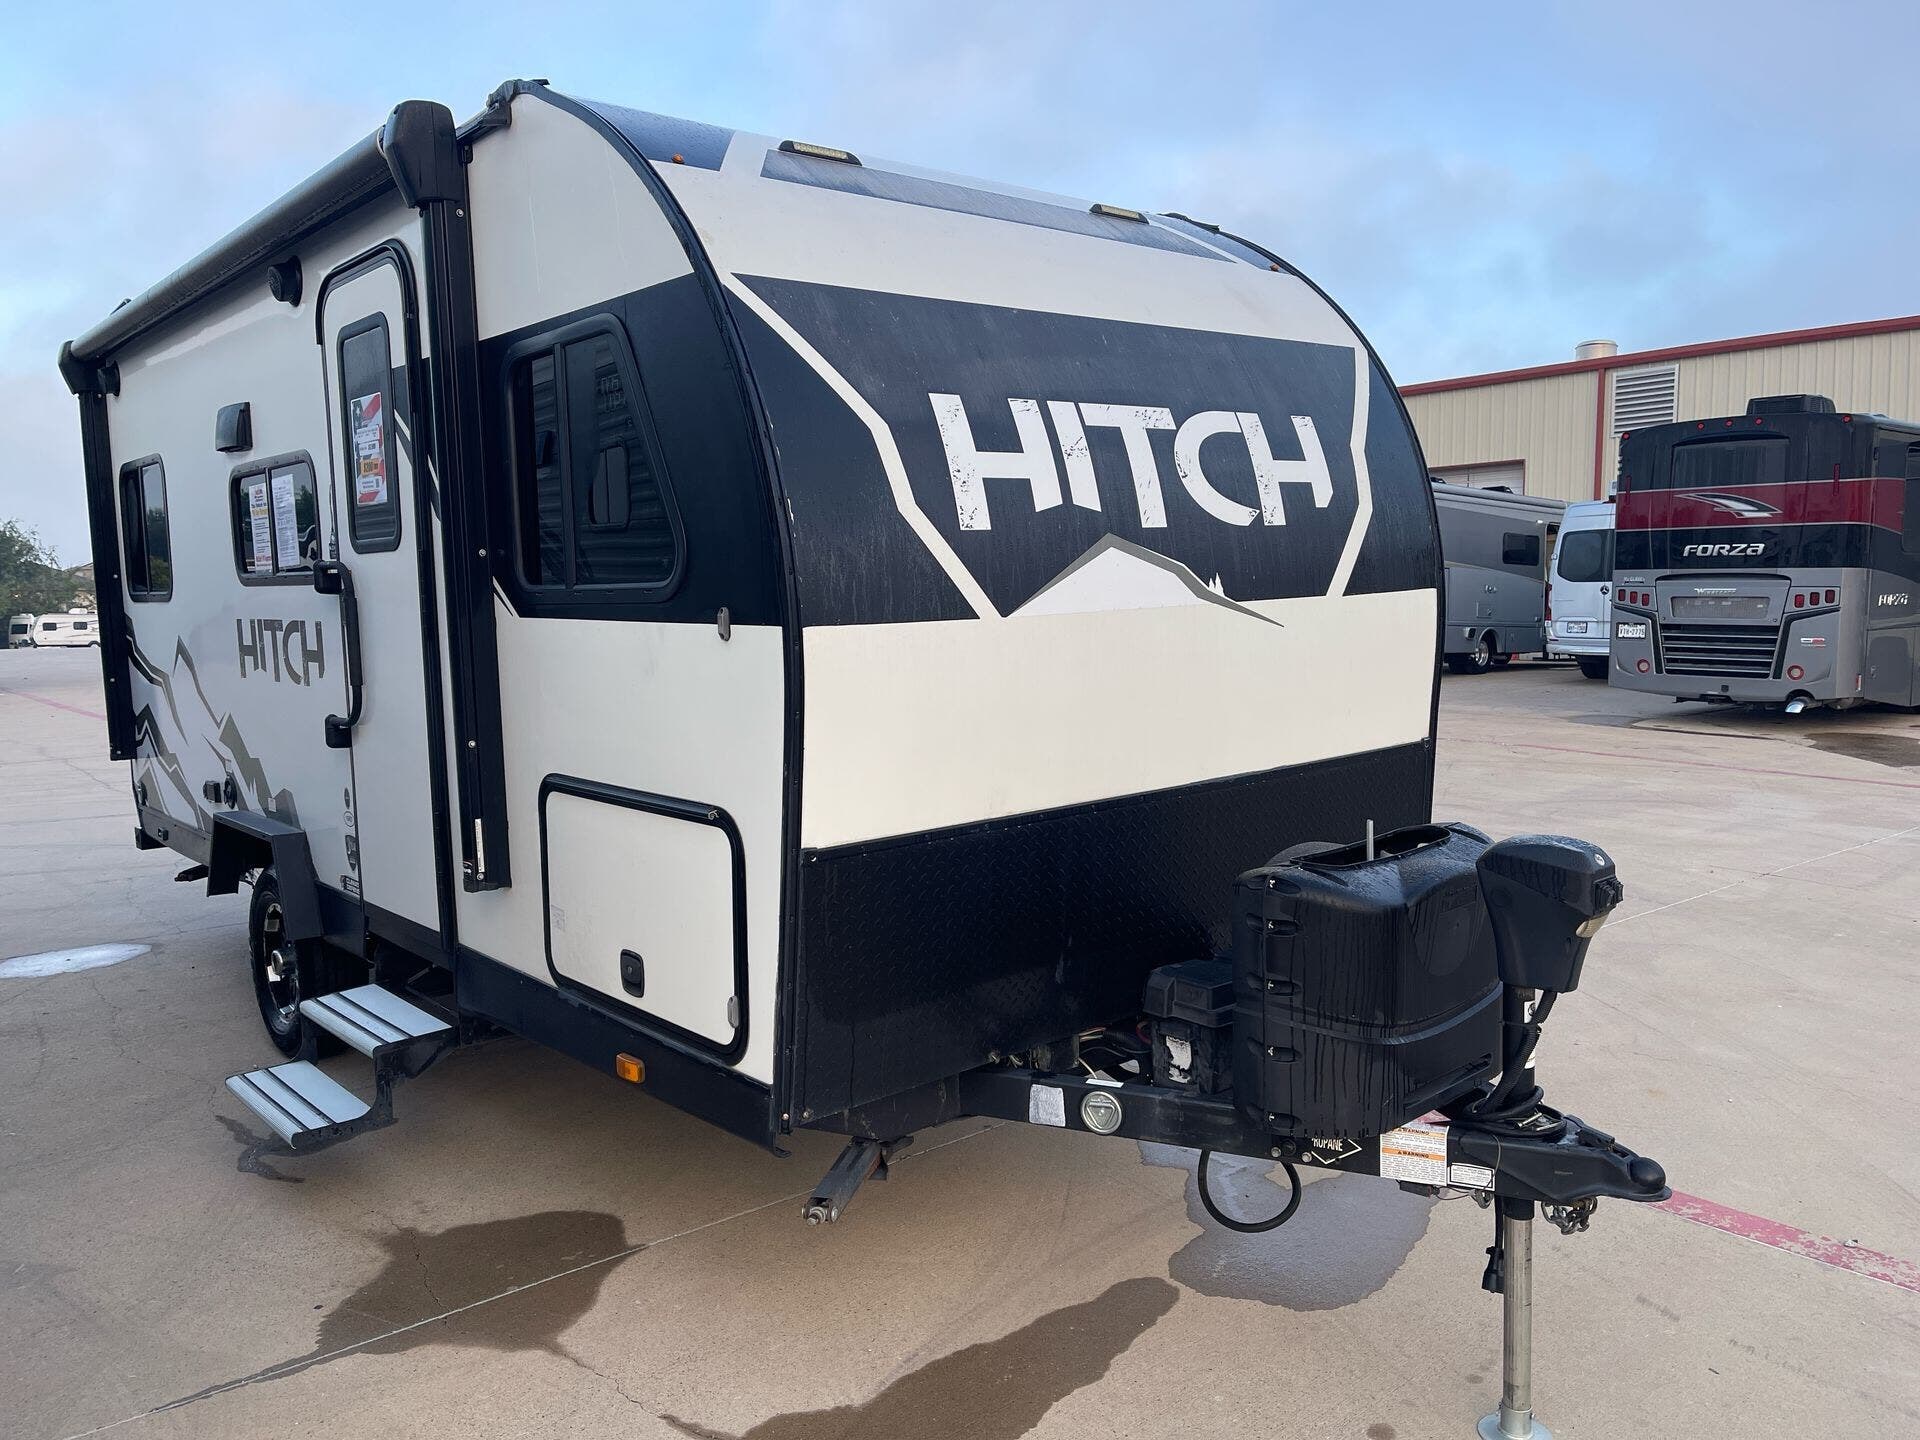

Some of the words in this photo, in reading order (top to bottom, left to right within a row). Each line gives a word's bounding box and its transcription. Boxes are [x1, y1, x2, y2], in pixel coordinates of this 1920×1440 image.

[928, 392, 1334, 531] HITCH
[1683, 543, 1766, 557] FORZA
[236, 618, 325, 687] HITCH
[1312, 1138, 1343, 1151] ROPANE
[1403, 1150, 1430, 1159] WARNING
